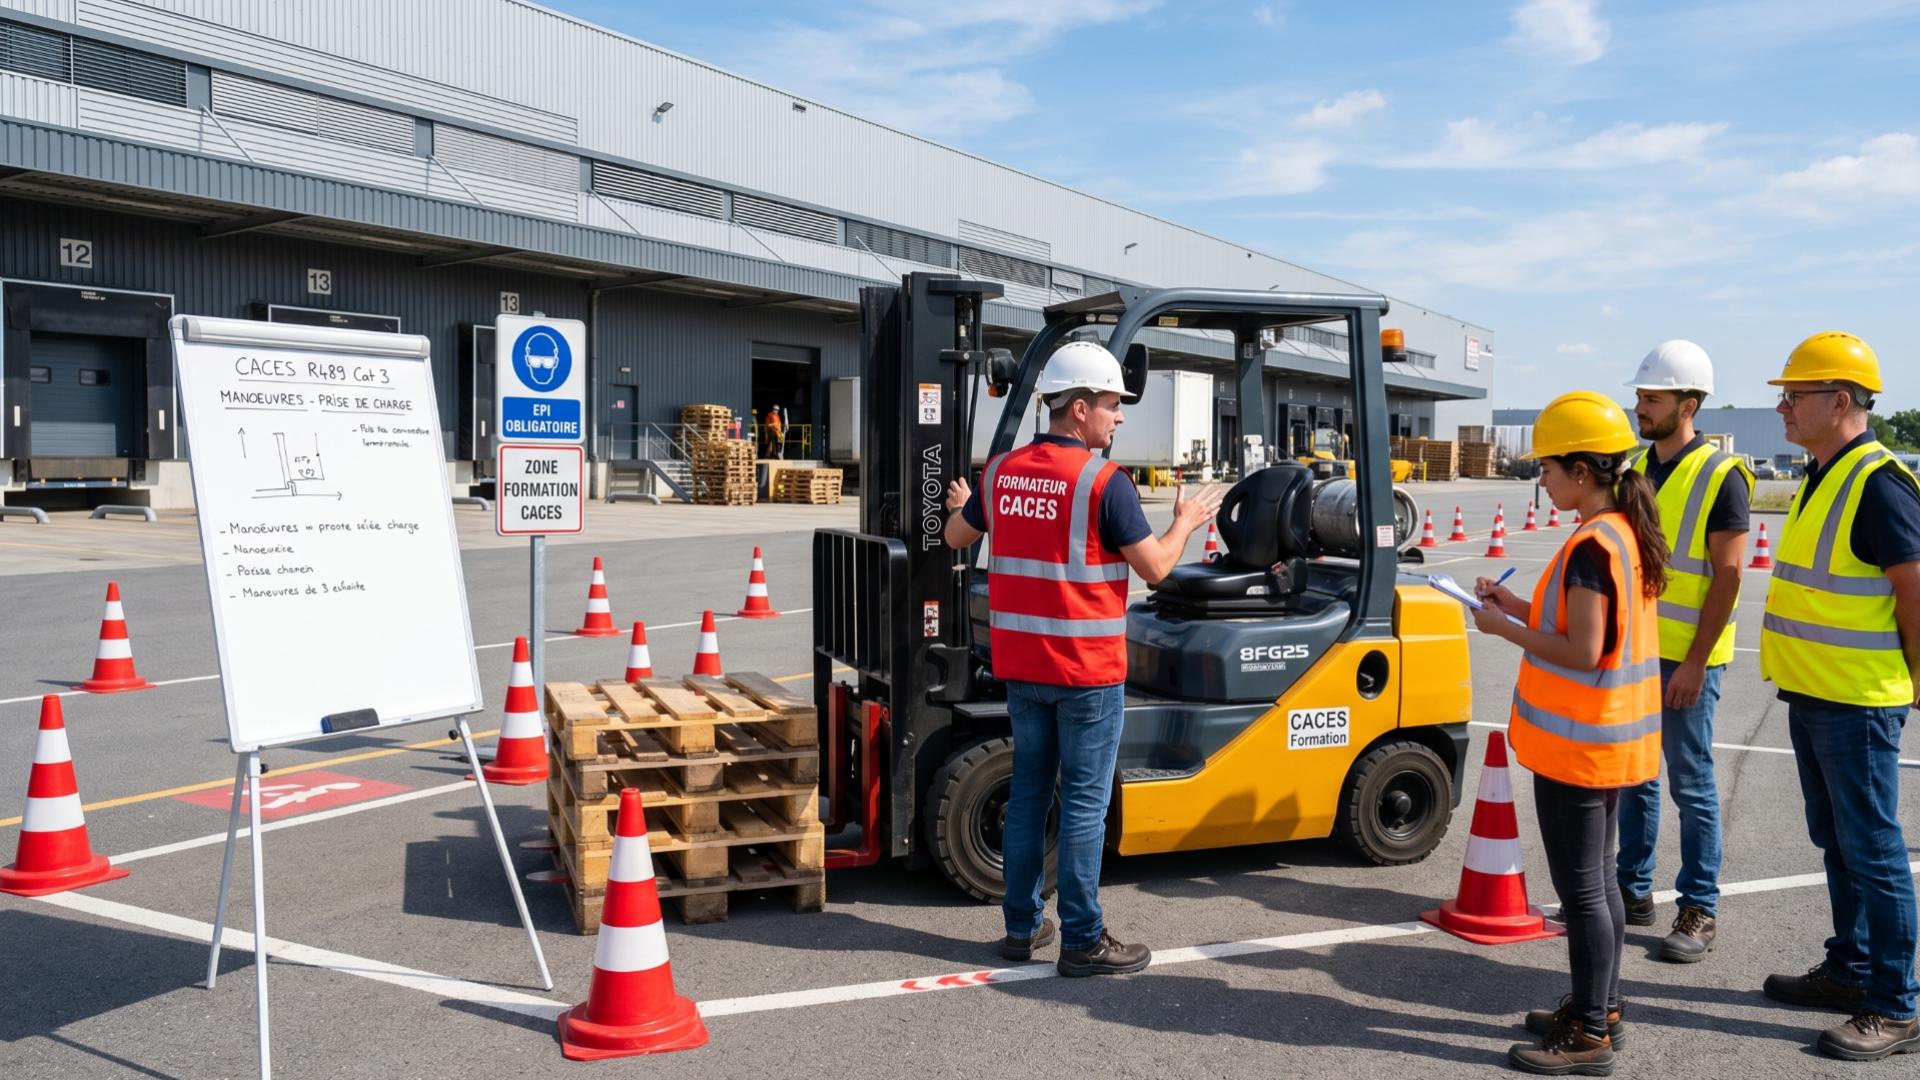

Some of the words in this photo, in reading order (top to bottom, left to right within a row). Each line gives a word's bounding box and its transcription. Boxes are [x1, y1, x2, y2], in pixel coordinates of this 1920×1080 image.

[62, 243, 90, 266] 12
[309, 273, 329, 293] 13
[502, 295, 518, 311] 13
[235, 357, 296, 376] CACES
[308, 362, 345, 380] R489
[354, 367, 375, 381] Cat
[380, 369, 389, 384] 3
[220, 390, 304, 405] MANOEUVRES
[355, 398, 369, 408] DE
[374, 399, 412, 410] CHARGE
[533, 404, 550, 416] EPI
[505, 420, 578, 434] OBLIGATOIRE
[525, 460, 557, 474] ZONE
[504, 482, 578, 497] FORMATION
[997, 475, 1067, 496] FORMATEUR
[923, 444, 941, 550] TOYOTA
[521, 505, 562, 520] CACES
[1000, 495, 1057, 520] CACES
[387, 520, 419, 534] charge
[305, 585, 317, 594] de
[322, 583, 328, 593] 3
[1240, 644, 1309, 661] 8FG25
[1291, 710, 1346, 731] CACES
[1291, 732, 1346, 747] Formation
